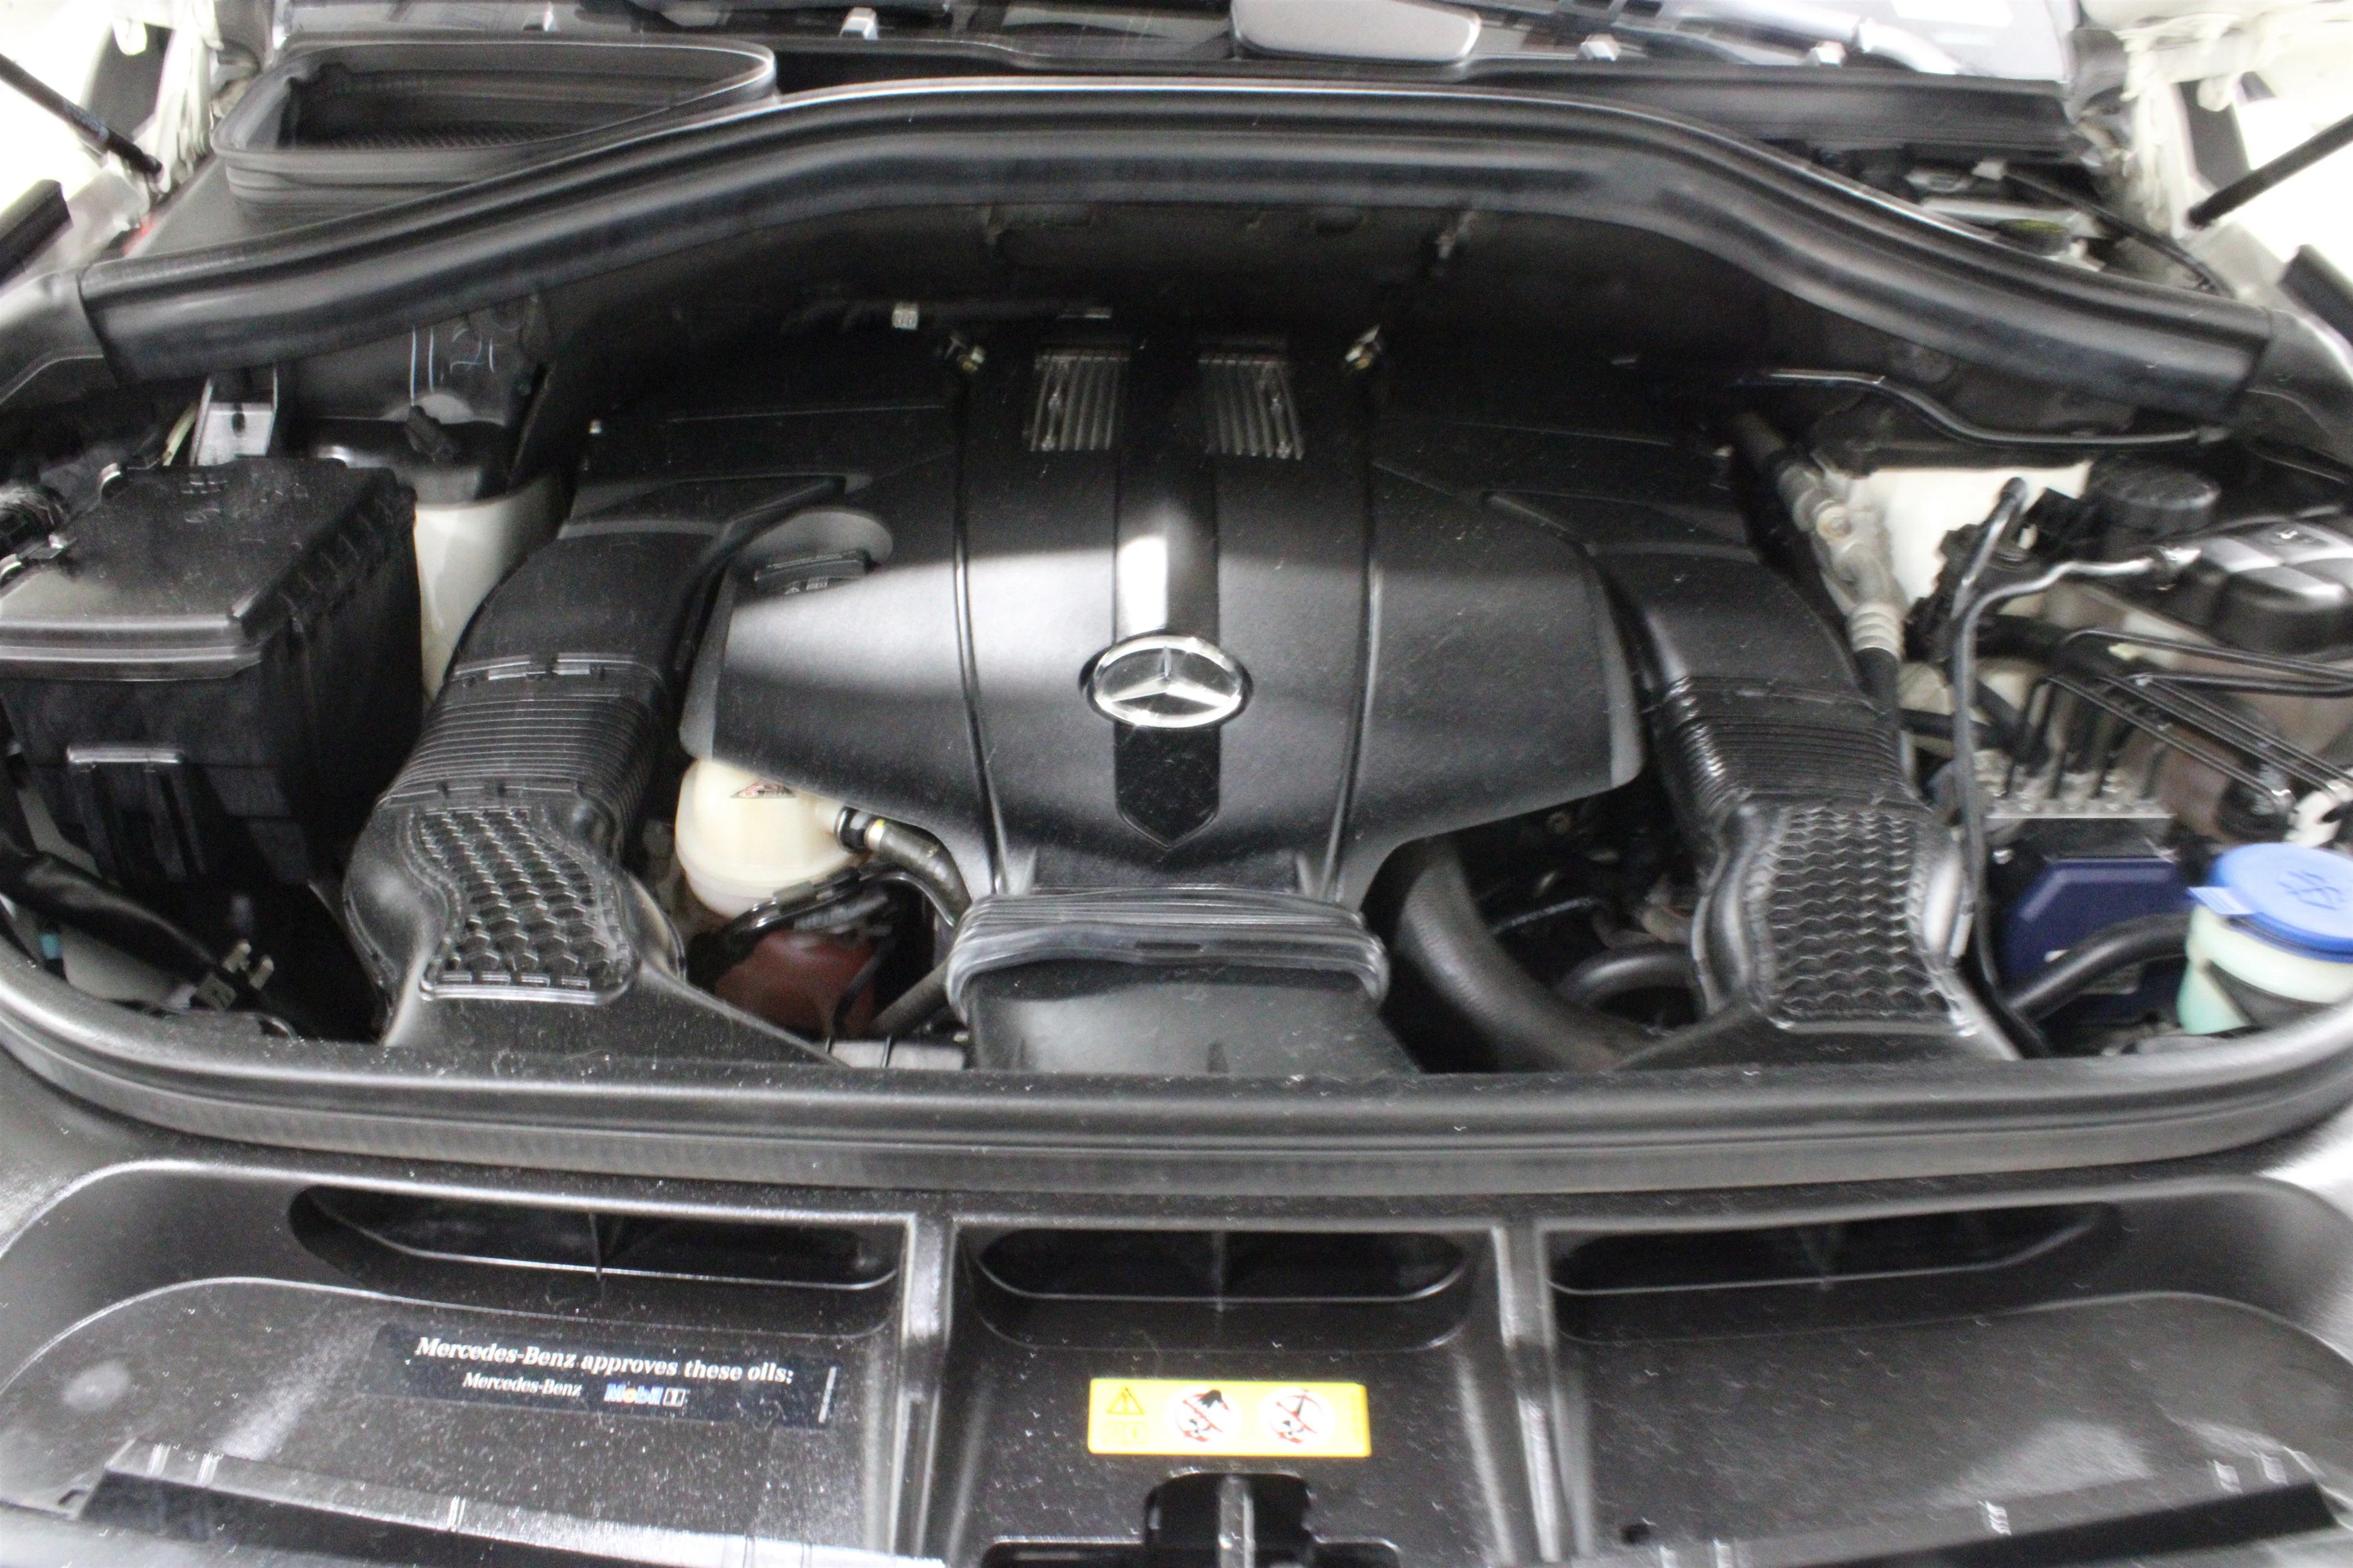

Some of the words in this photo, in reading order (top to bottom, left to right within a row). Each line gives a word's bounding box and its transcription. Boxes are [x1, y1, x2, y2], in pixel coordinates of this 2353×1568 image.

[415, 1337, 577, 1368] Mercedes-Benz
[580, 1354, 678, 1376] approves
[684, 1360, 743, 1381] these
[461, 1372, 583, 1397] Mercedes-Benz
